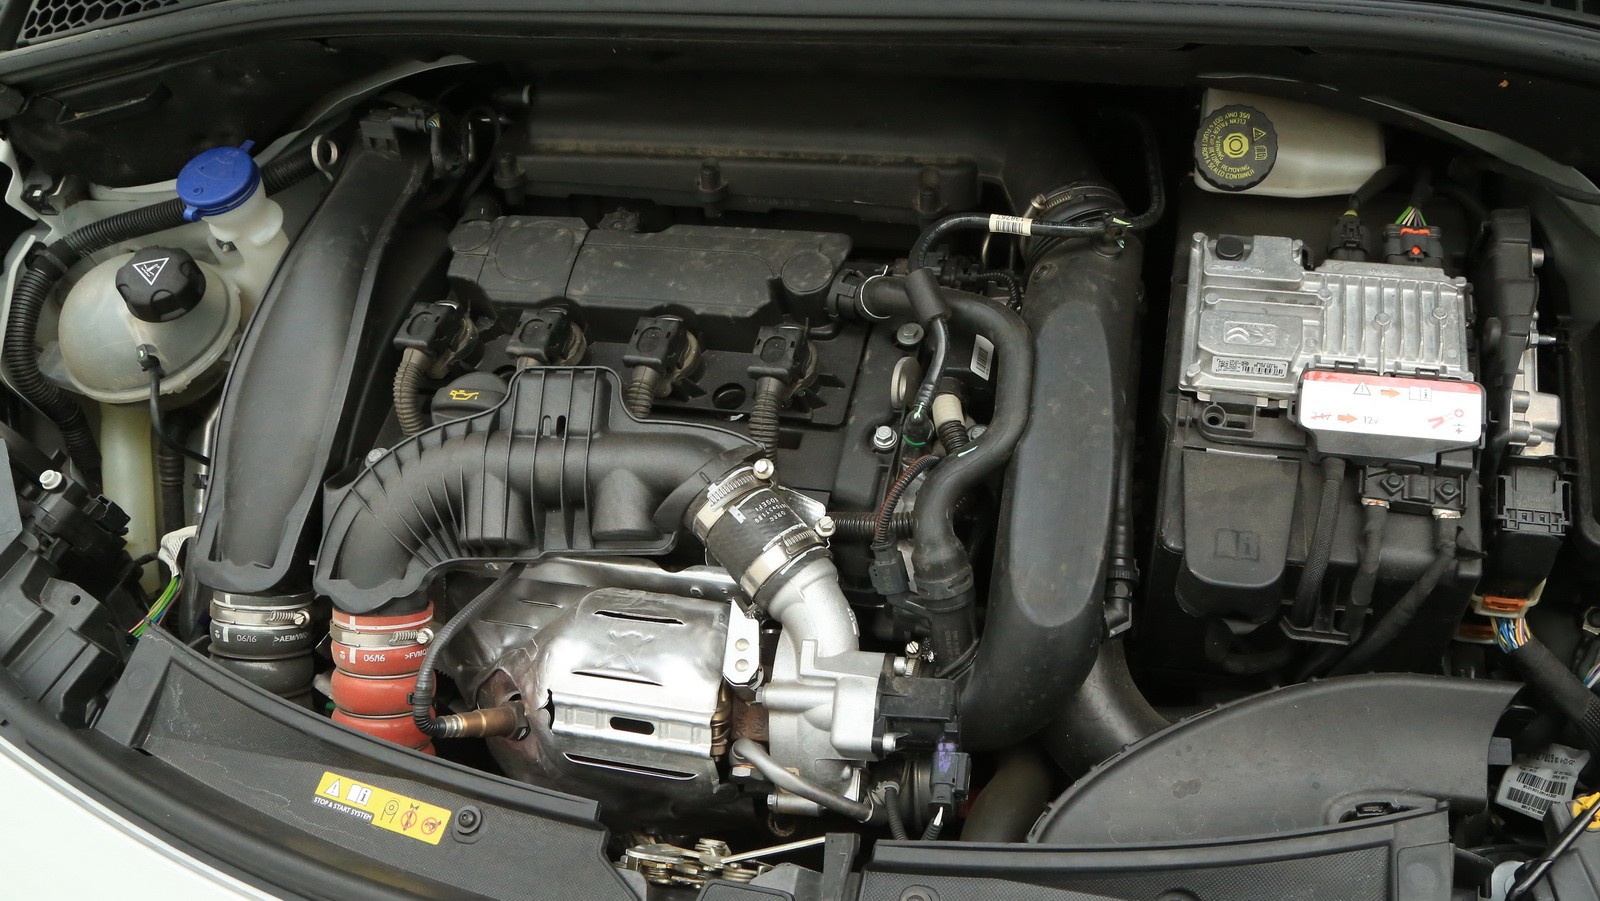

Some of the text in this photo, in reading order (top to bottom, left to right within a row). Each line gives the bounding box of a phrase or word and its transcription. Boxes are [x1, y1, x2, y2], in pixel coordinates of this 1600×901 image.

[236, 634, 257, 643] 06/16
[363, 653, 385, 663] 06/16
[314, 796, 328, 805] STOP
[333, 803, 350, 814] START
[350, 809, 372, 820] SYSTEM
